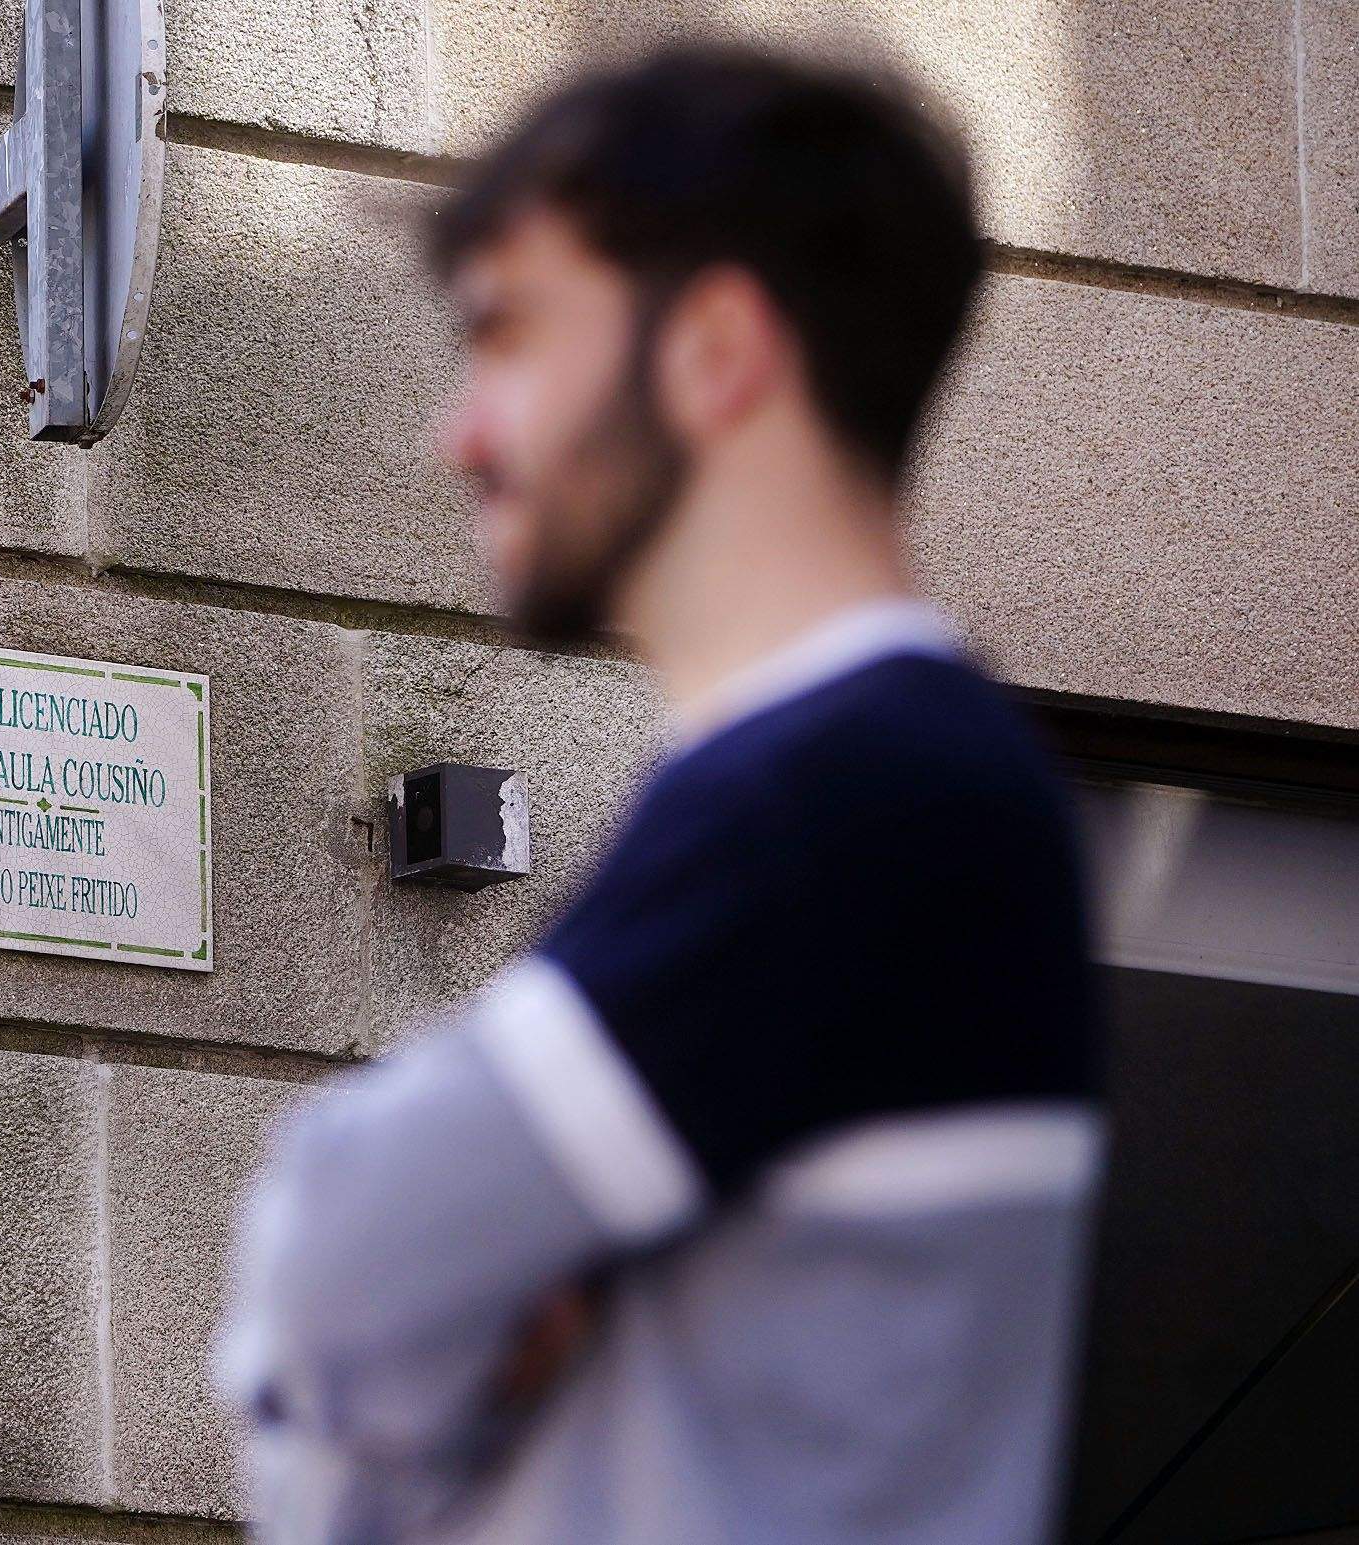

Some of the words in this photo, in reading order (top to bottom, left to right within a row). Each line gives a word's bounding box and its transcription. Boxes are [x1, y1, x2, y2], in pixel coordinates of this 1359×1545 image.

[62, 758, 166, 808] COUSIÑO
[19, 871, 67, 910] PEIXE
[72, 878, 138, 919] FRITIDO
